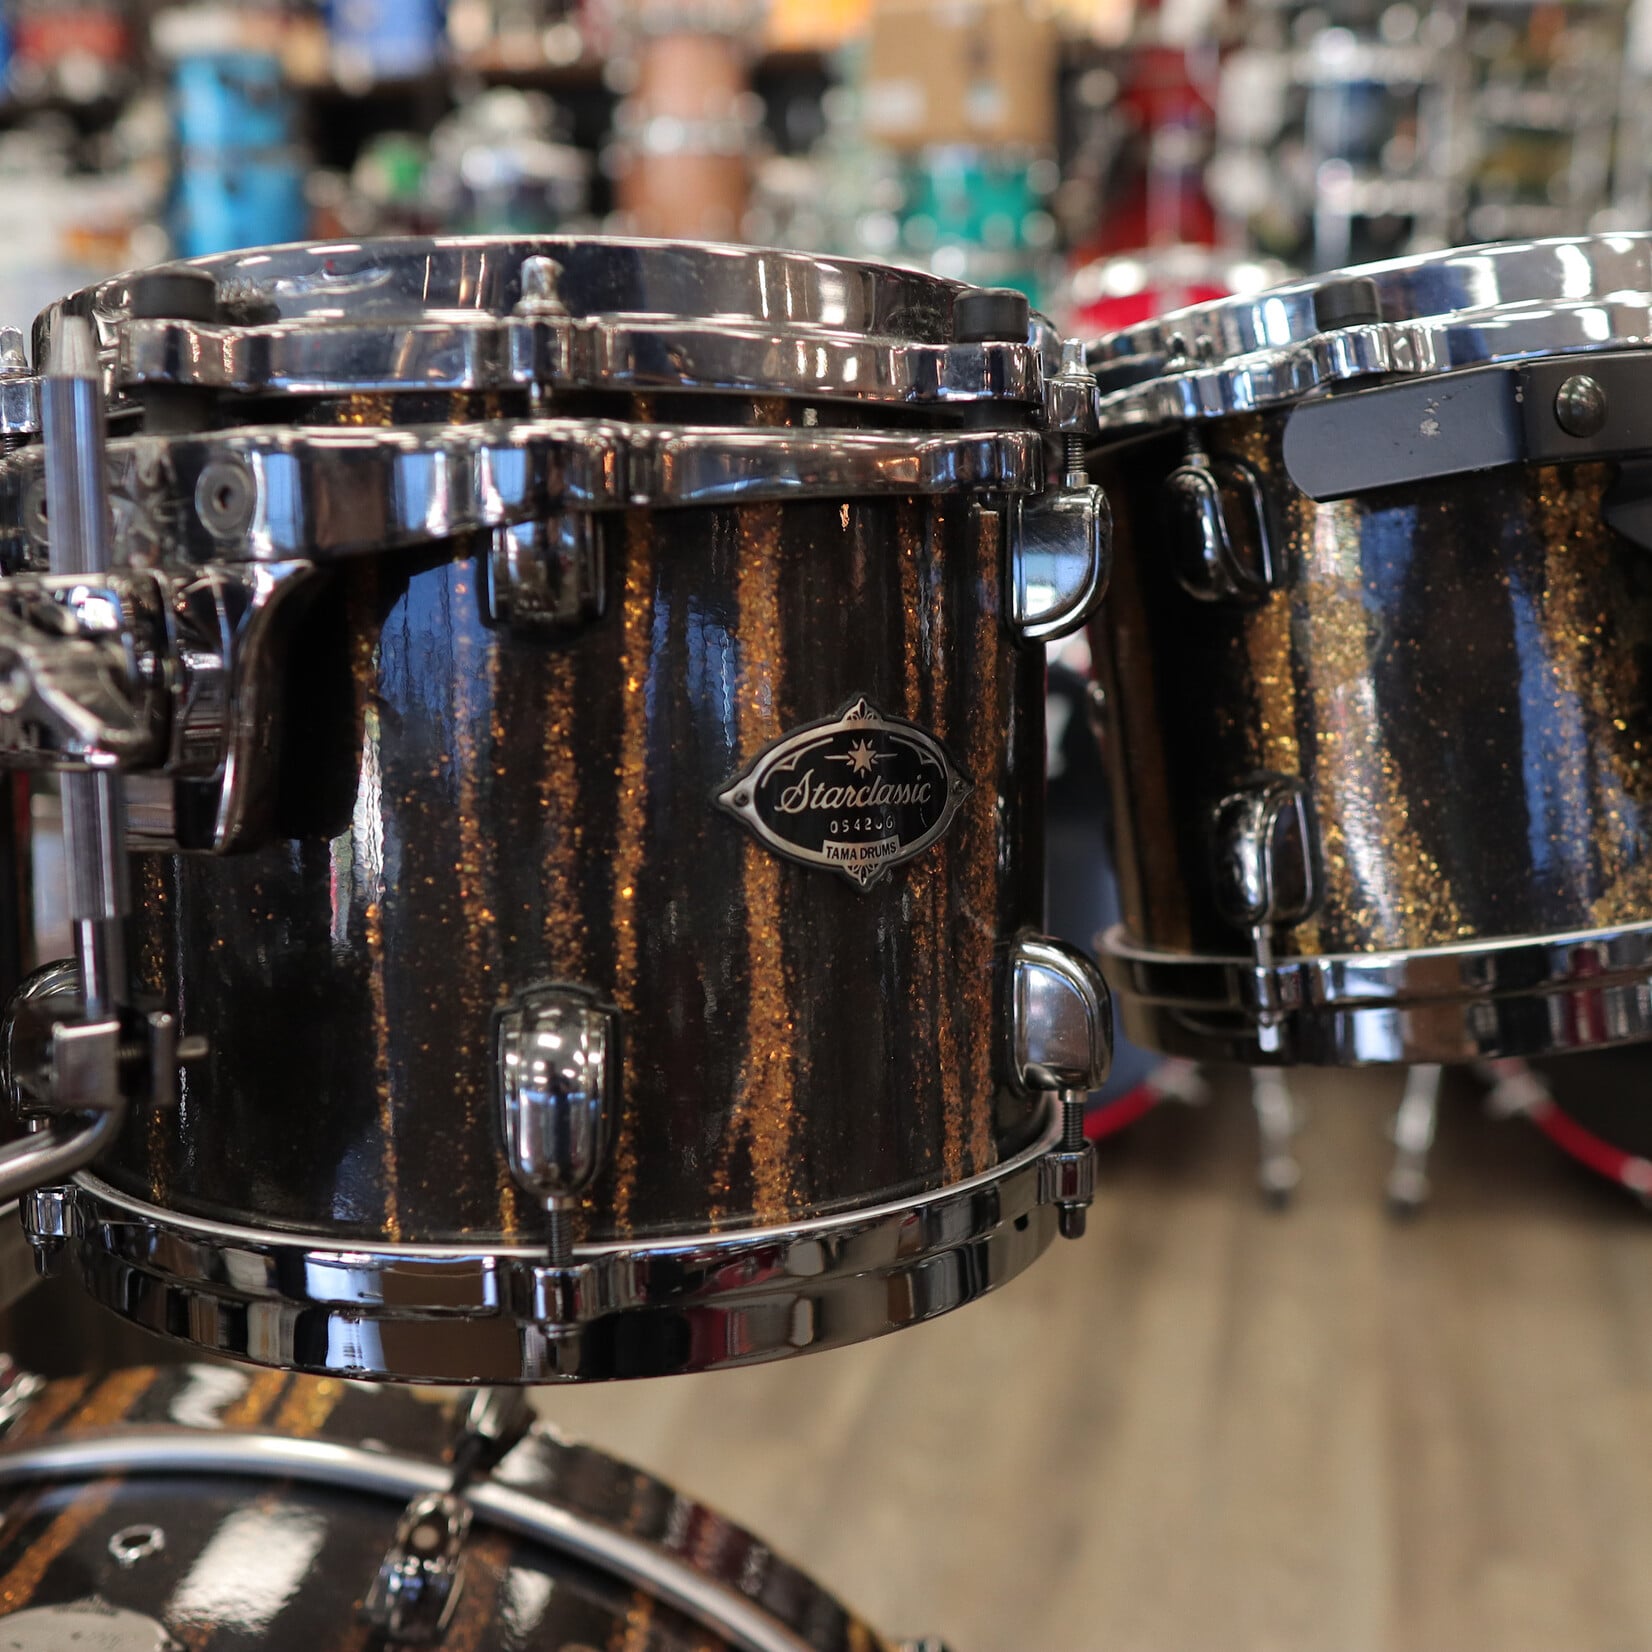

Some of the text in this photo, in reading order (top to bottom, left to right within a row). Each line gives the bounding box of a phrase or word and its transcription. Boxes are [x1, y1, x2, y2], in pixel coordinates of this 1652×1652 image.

[774, 768, 932, 814] Starclassic
[826, 841, 897, 860] TAMA DRUMS
